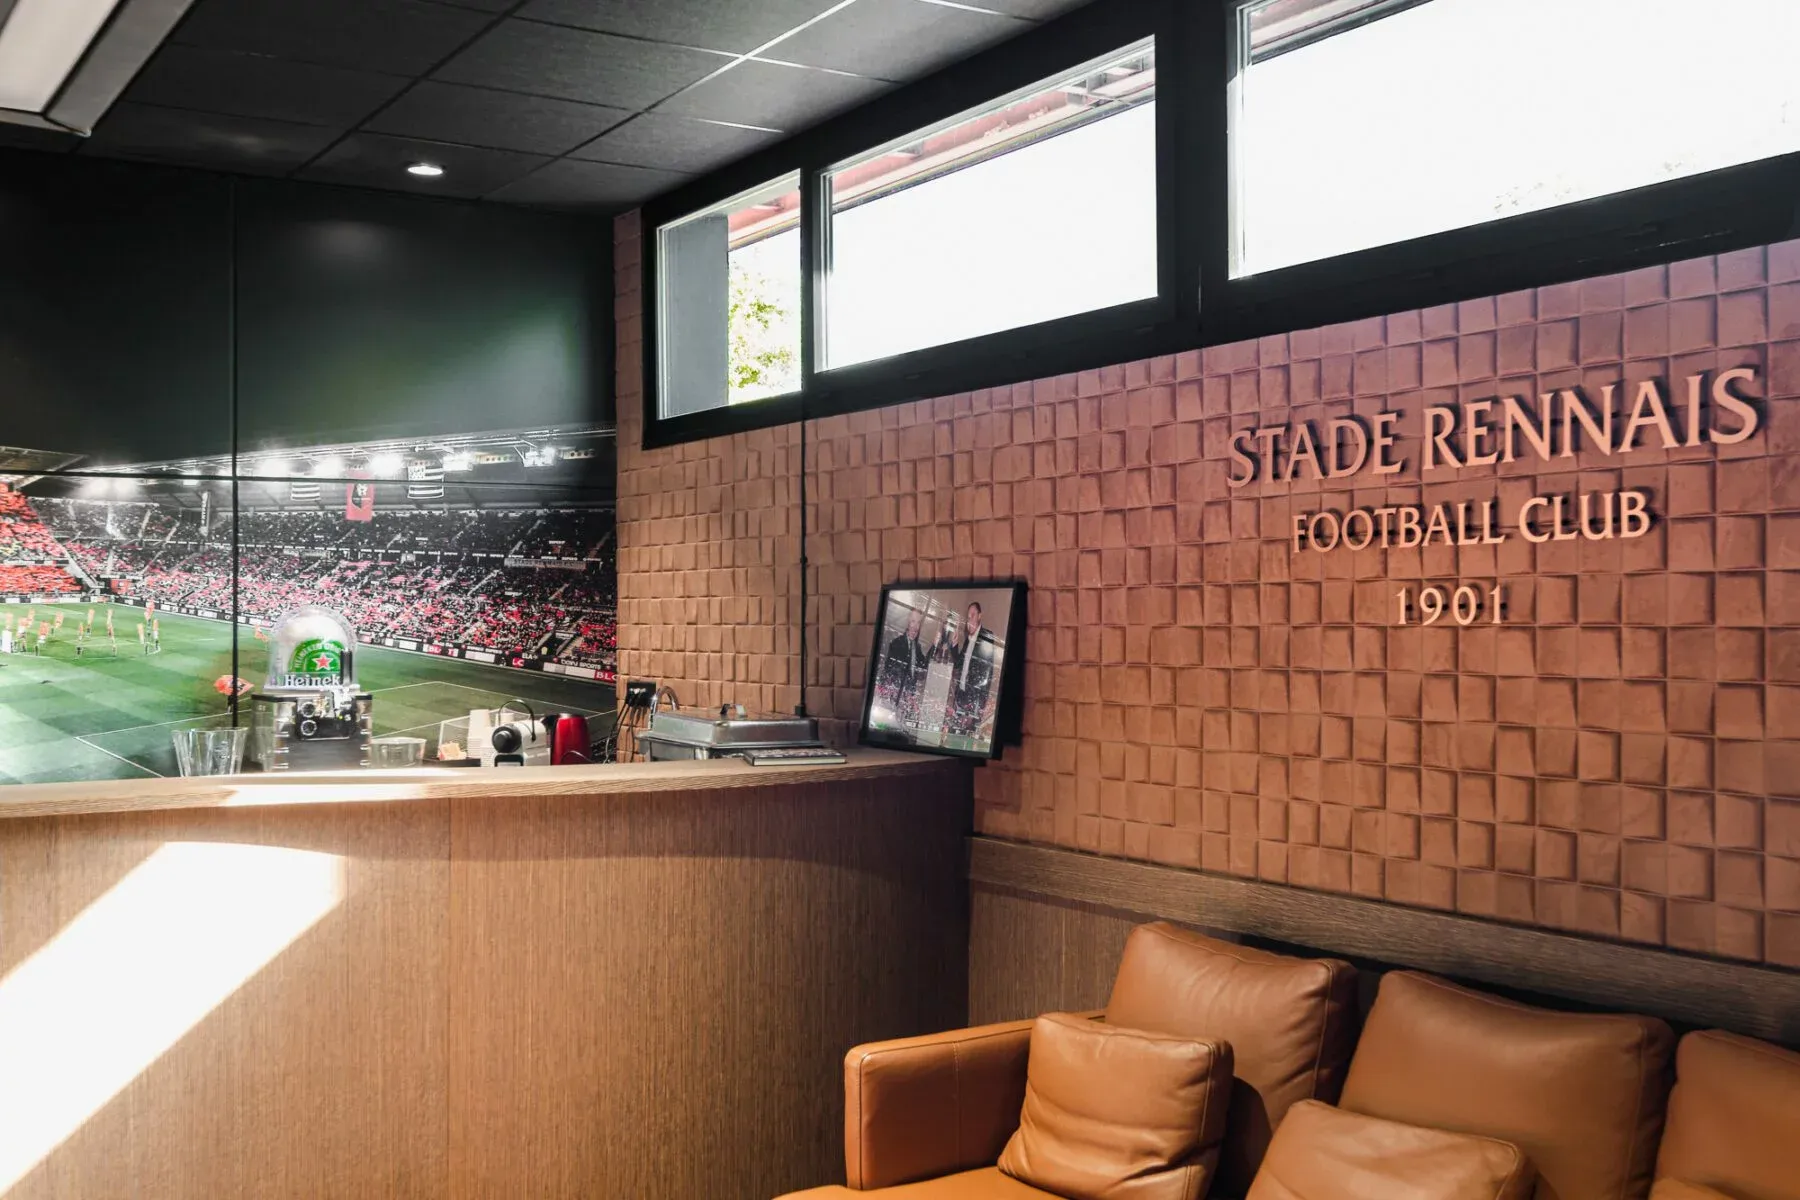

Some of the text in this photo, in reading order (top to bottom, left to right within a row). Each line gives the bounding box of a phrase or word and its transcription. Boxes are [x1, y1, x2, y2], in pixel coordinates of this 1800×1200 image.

[1226, 367, 1759, 488] STADE RENNAIS
[1291, 490, 1651, 553] FOOTBALL CLUB
[1396, 585, 1502, 625] 1901
[284, 674, 342, 687] Heinek
